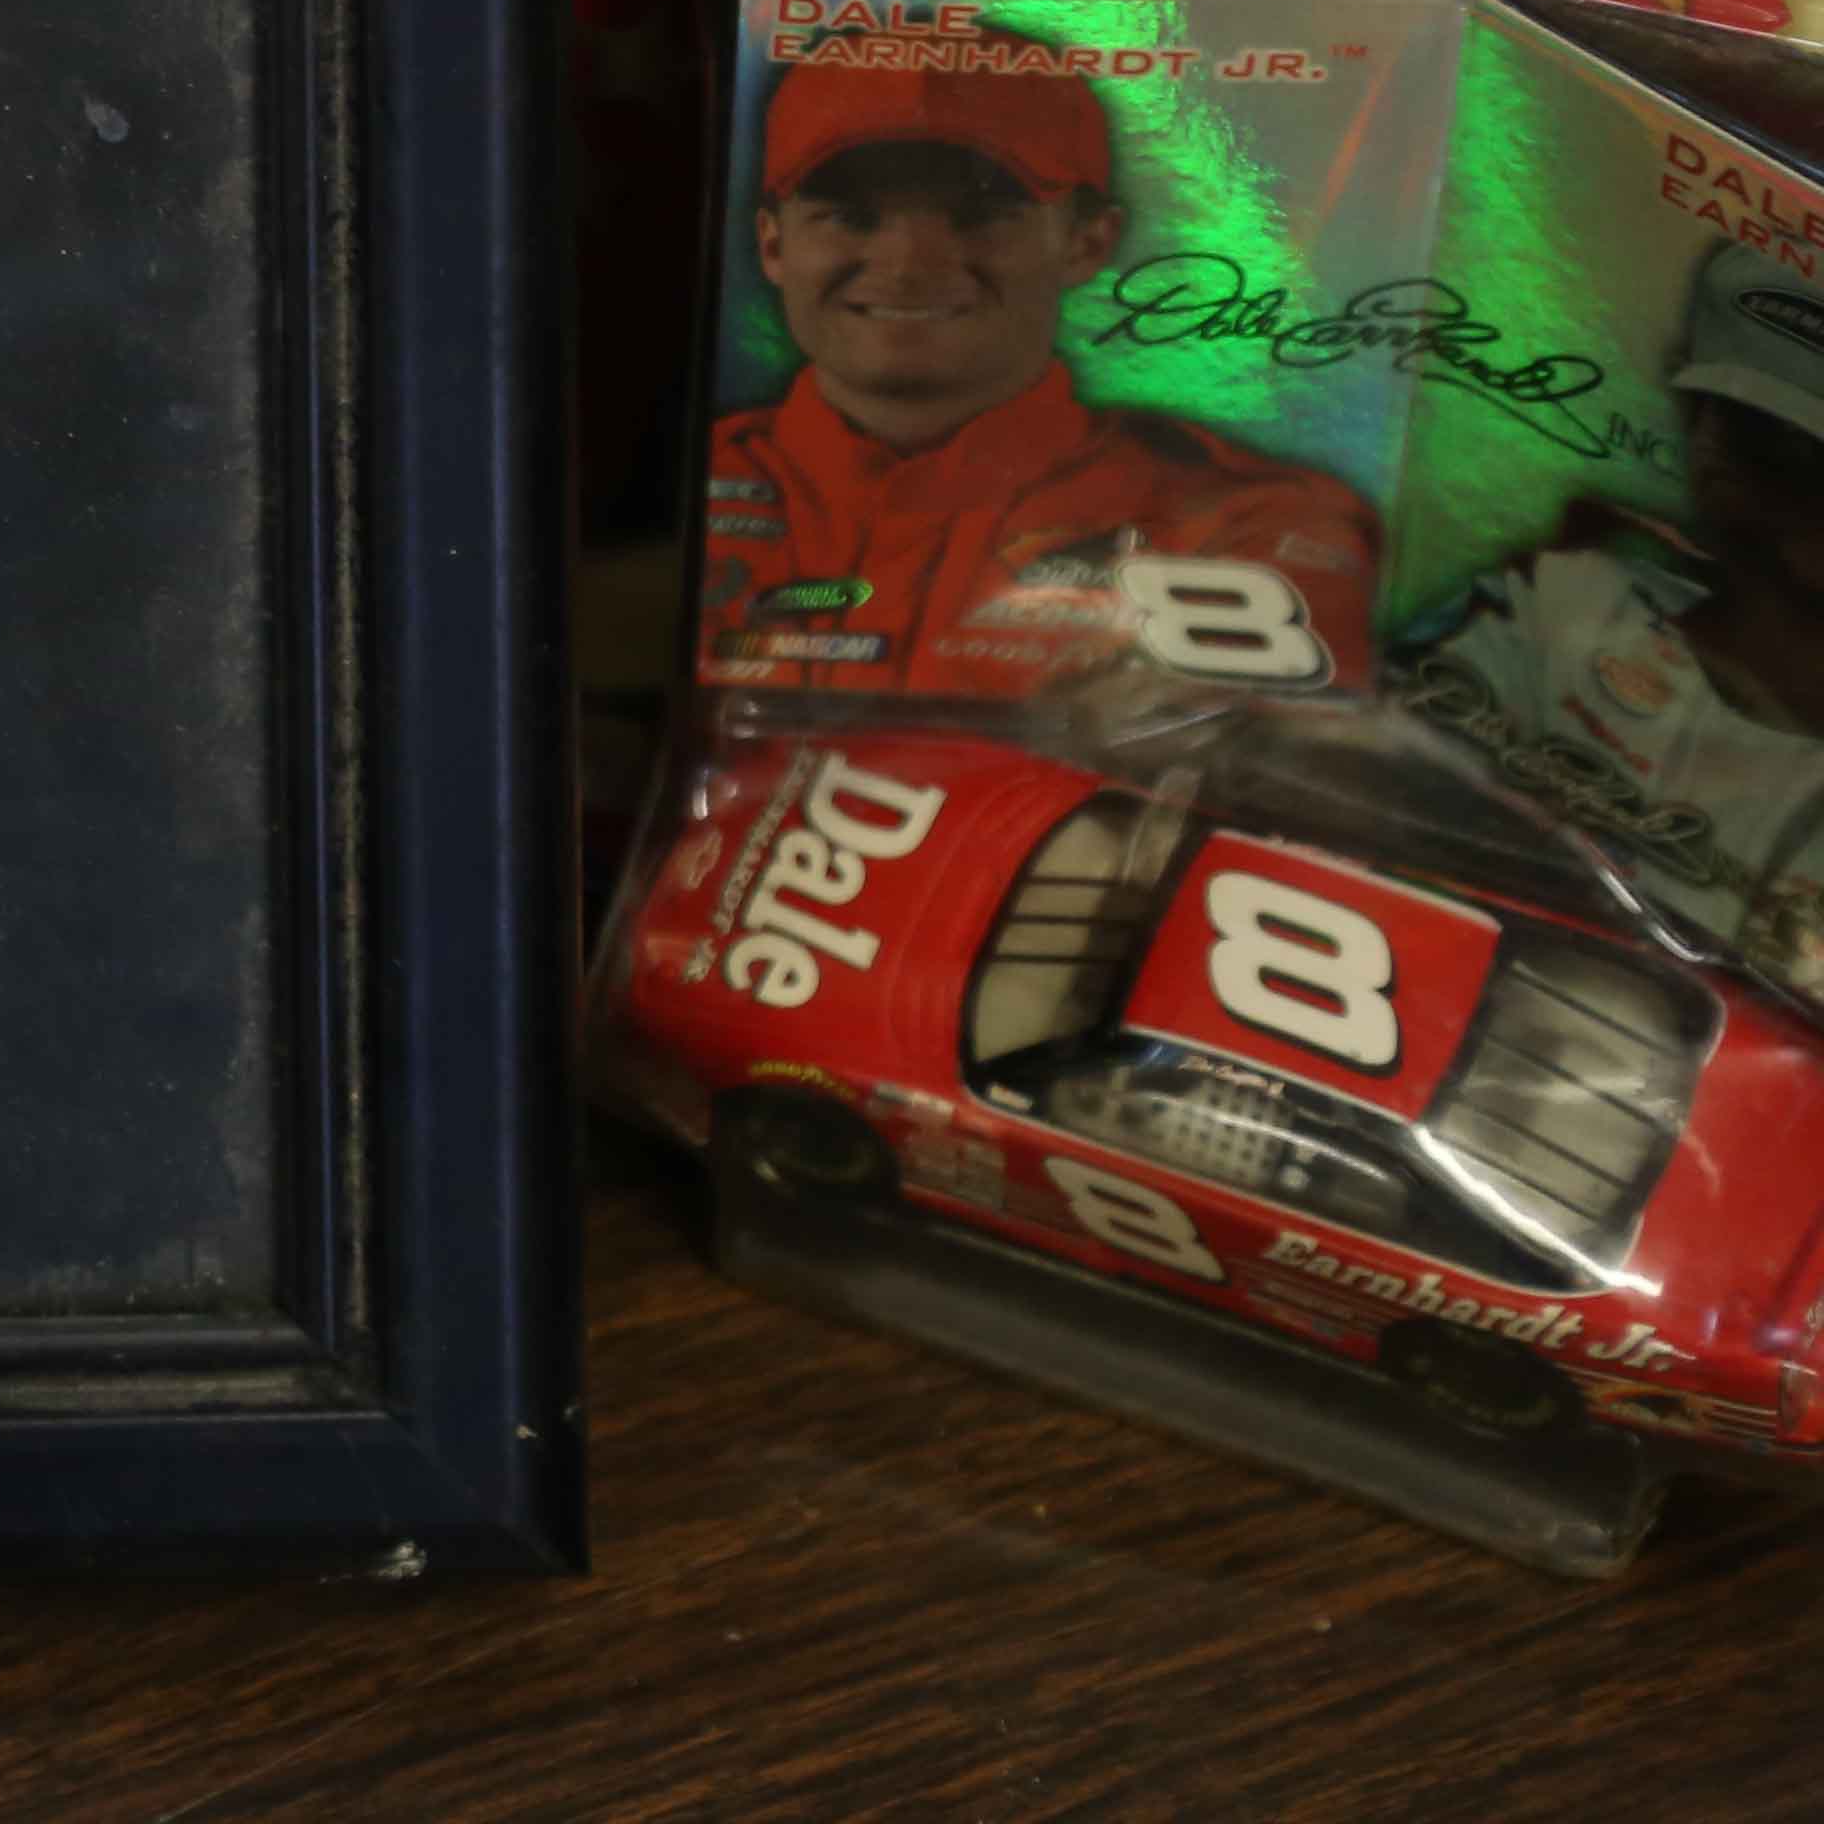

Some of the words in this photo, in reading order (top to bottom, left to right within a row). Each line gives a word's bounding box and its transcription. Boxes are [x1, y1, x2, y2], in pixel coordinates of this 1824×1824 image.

[768, 33, 1201, 79] EARNHARDT
[1222, 51, 1328, 80] JR.
[1119, 554, 1324, 680] 8
[721, 749, 949, 1009] Dale
[1204, 870, 1400, 1072] 8
[1043, 1156, 1227, 1282] 8
[1262, 1229, 1584, 1350] Earnhardt
